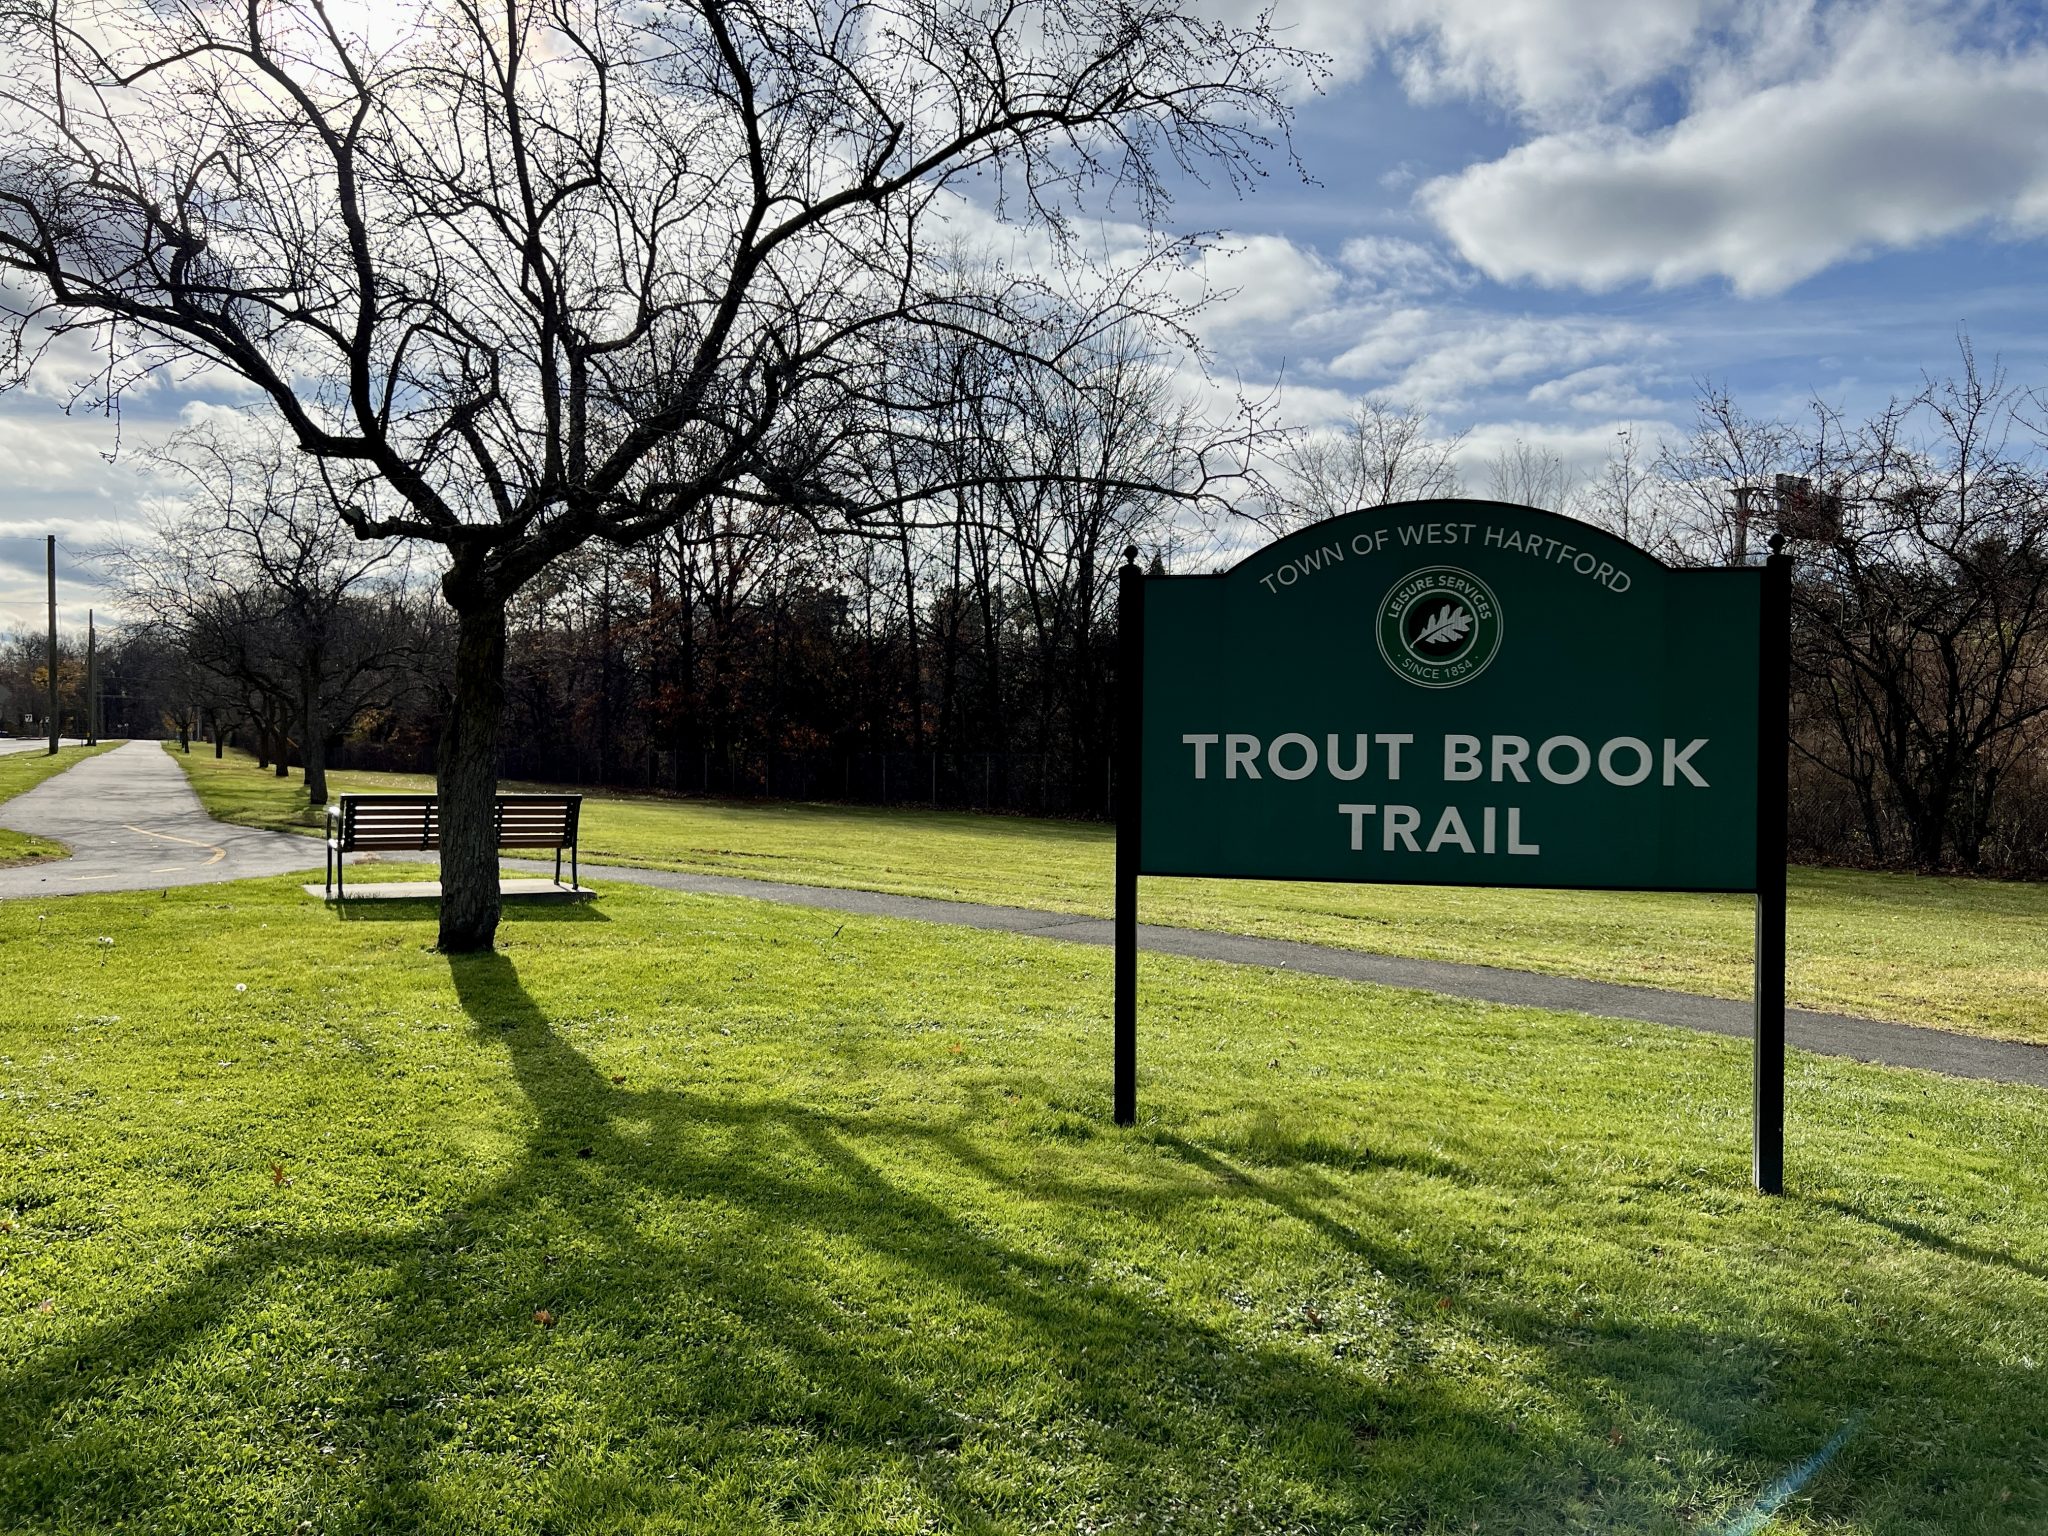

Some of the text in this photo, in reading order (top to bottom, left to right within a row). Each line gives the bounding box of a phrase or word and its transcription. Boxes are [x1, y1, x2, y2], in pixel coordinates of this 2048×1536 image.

[1259, 523, 1631, 595] TOWN OF WEST HARTFORD
[1388, 576, 1492, 620] LEISURE SERVICES
[1402, 658, 1473, 679] SINCE 1854
[1182, 733, 1710, 788] TROUT BROOK
[1338, 803, 1540, 855] TRAIL
